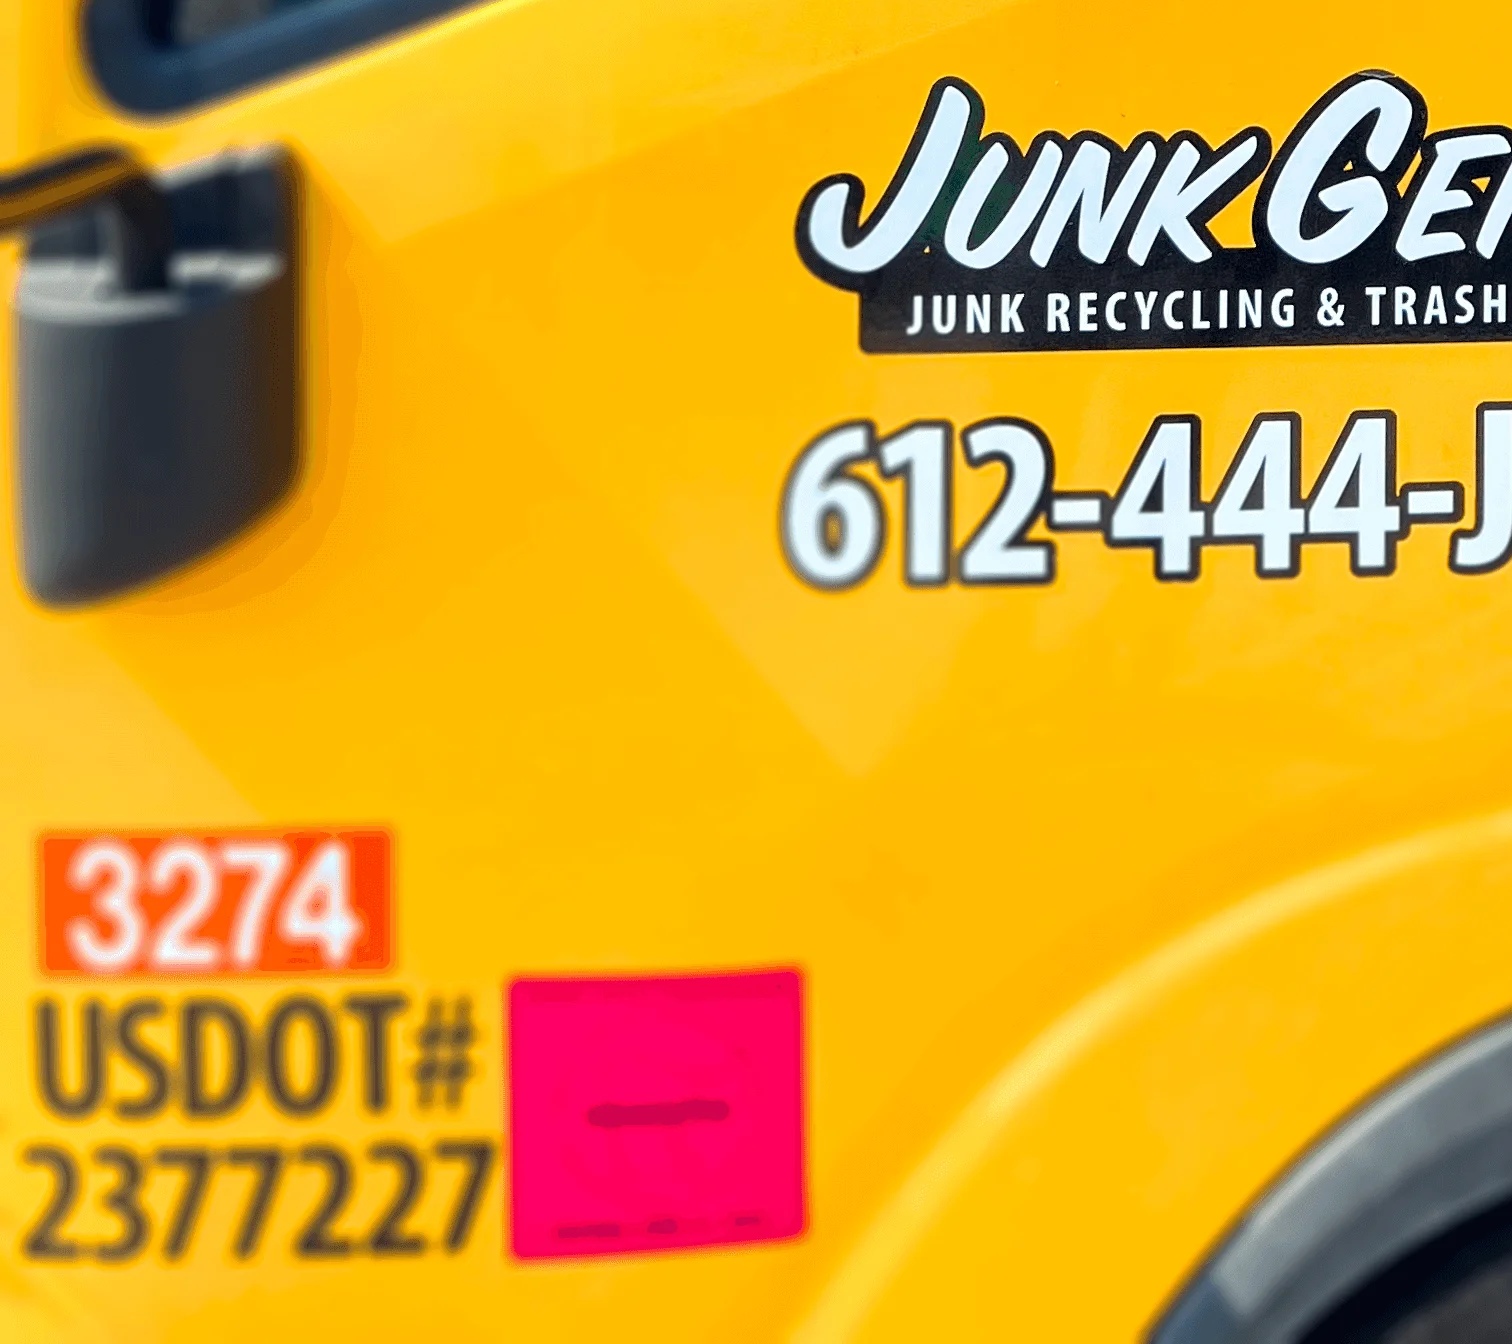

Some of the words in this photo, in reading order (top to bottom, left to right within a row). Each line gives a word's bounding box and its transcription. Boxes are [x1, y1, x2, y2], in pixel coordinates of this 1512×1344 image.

[807, 83, 1258, 274] JUNK
[904, 291, 1026, 337] JUNK
[1045, 287, 1296, 334] RECYCLING
[1315, 286, 1346, 328] &
[1364, 281, 1508, 327] TRASH
[67, 838, 362, 974] 3274
[35, 994, 476, 1120] USDOT#
[24, 1140, 497, 1262] 2377227
